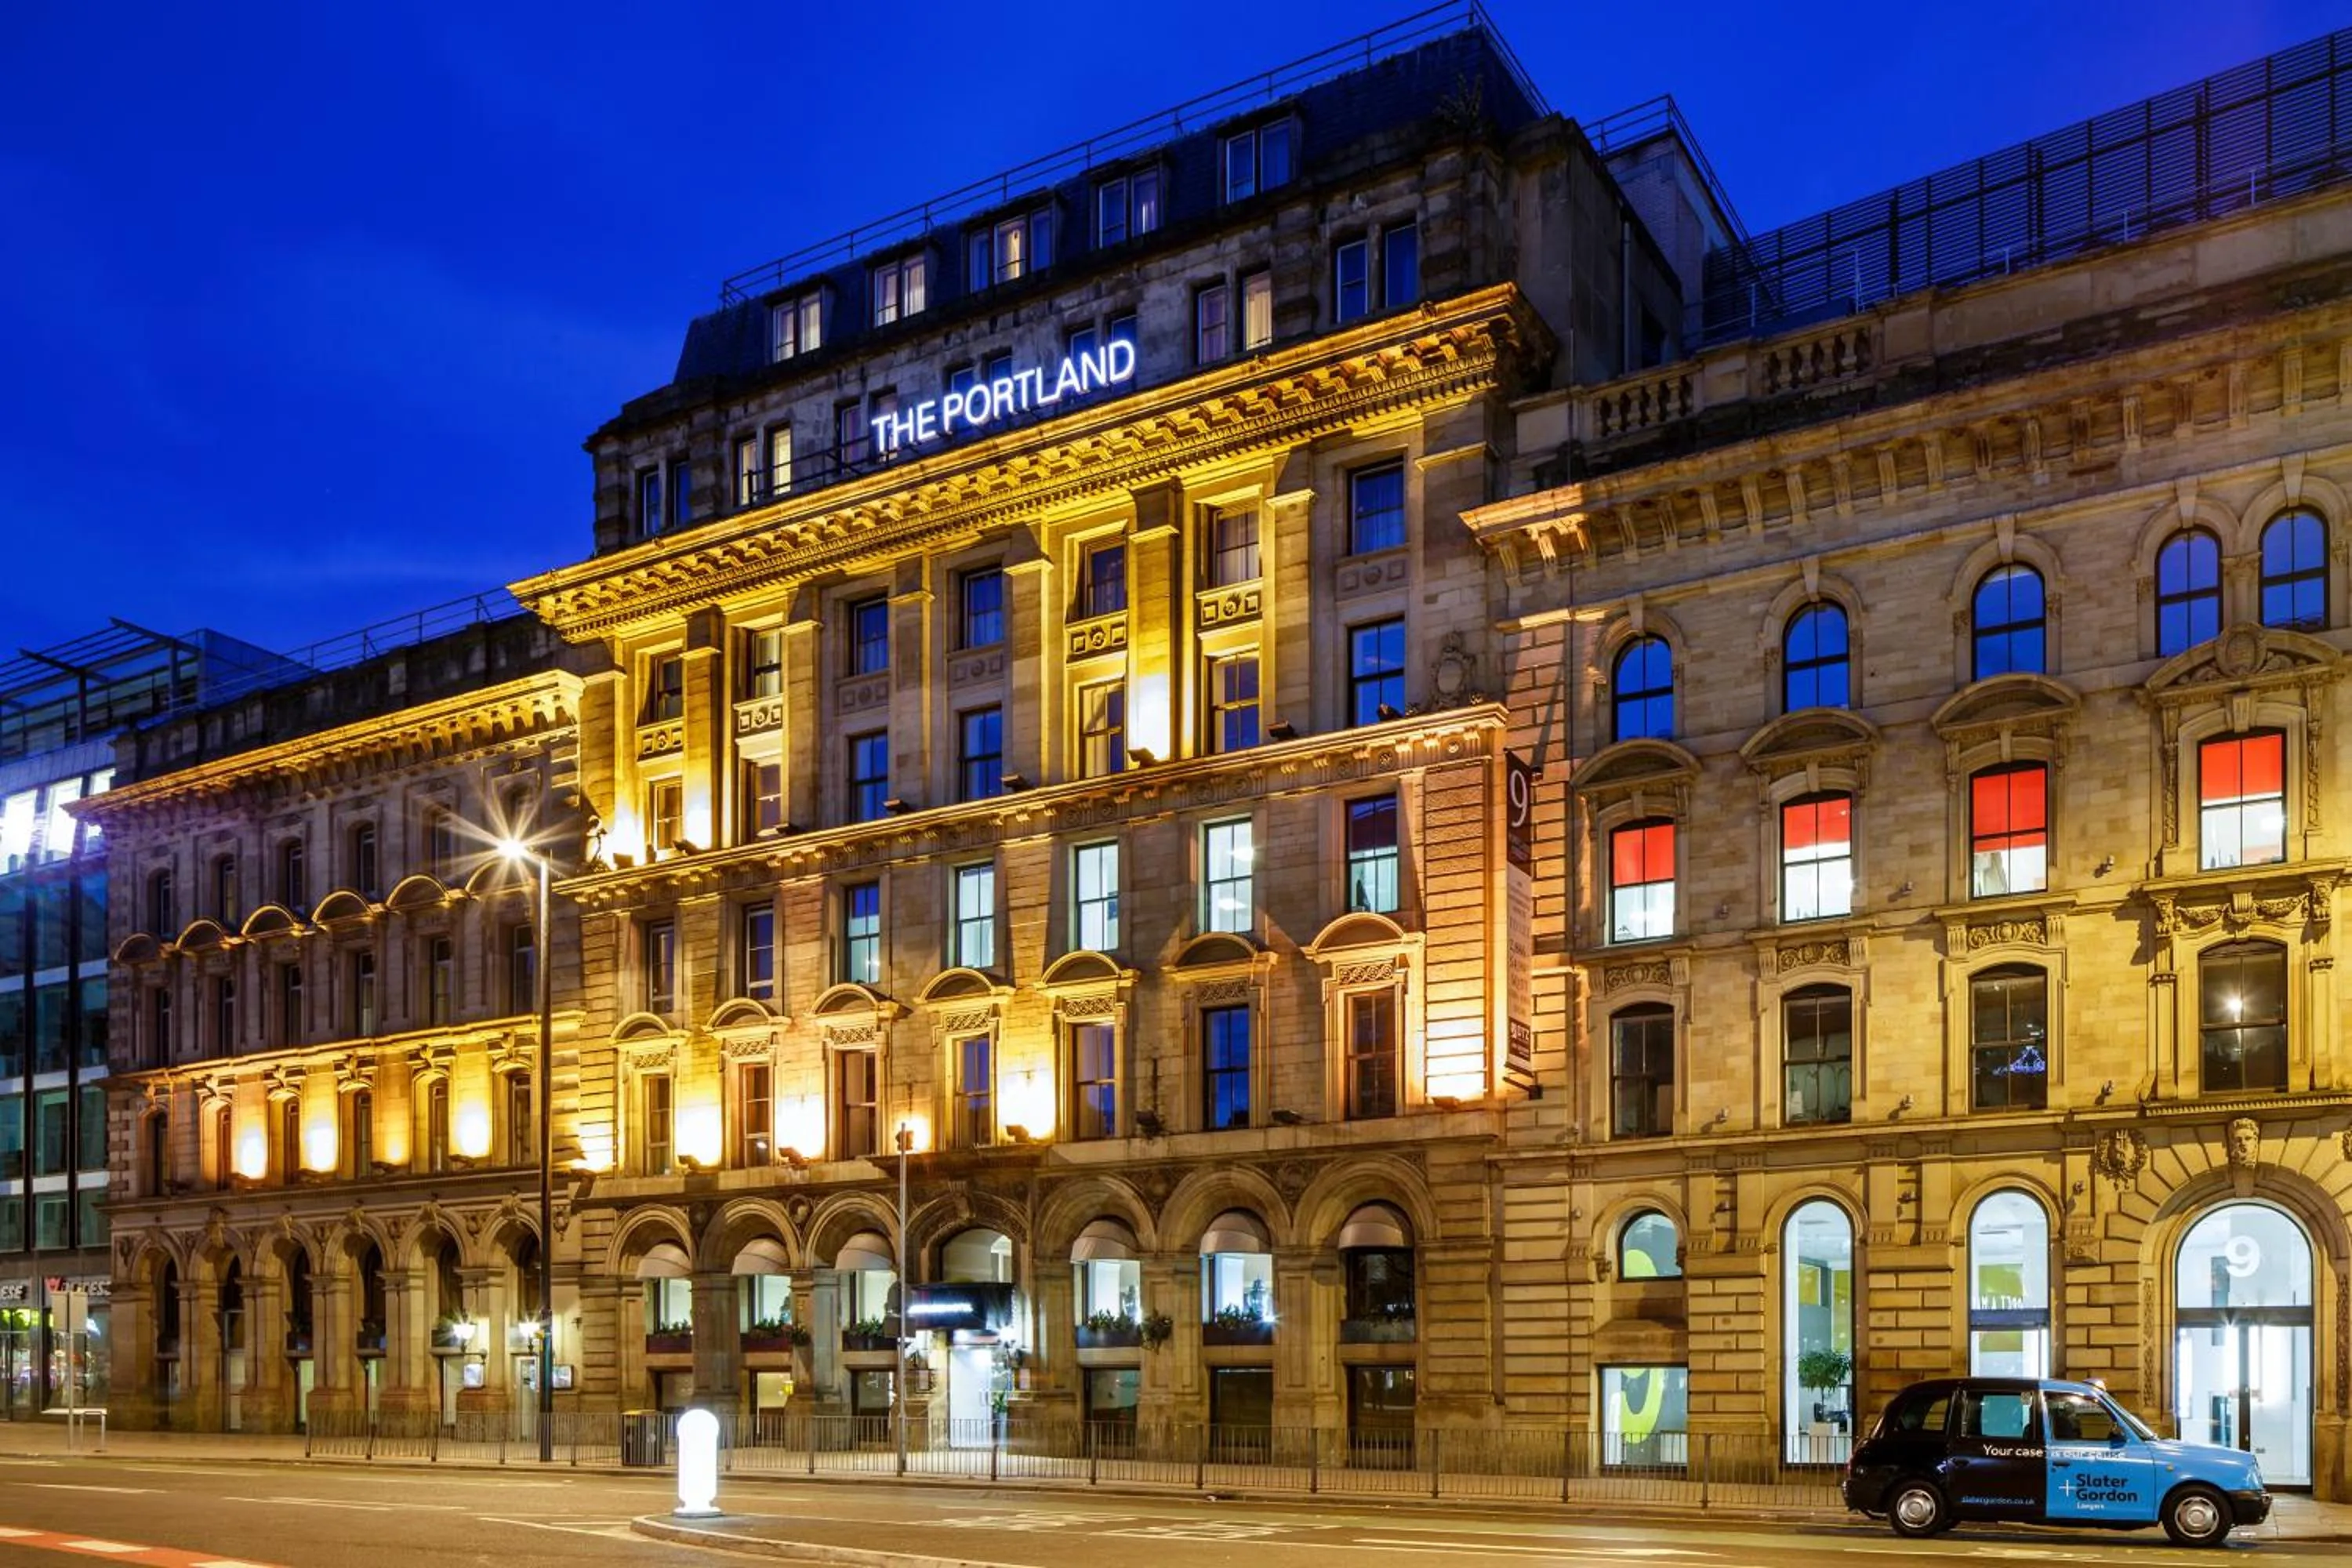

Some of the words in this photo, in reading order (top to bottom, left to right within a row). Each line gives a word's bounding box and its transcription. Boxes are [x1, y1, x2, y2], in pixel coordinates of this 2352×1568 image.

[871, 400, 938, 455] THE
[943, 339, 1136, 434] PORTLAND
[1509, 768, 1528, 828] 9
[2224, 1236, 2261, 1278] 9
[1983, 1444, 2013, 1456] Your
[2016, 1446, 2043, 1457] case
[2076, 1473, 2129, 1487] Slater
[2076, 1488, 2137, 1502] Gordon
